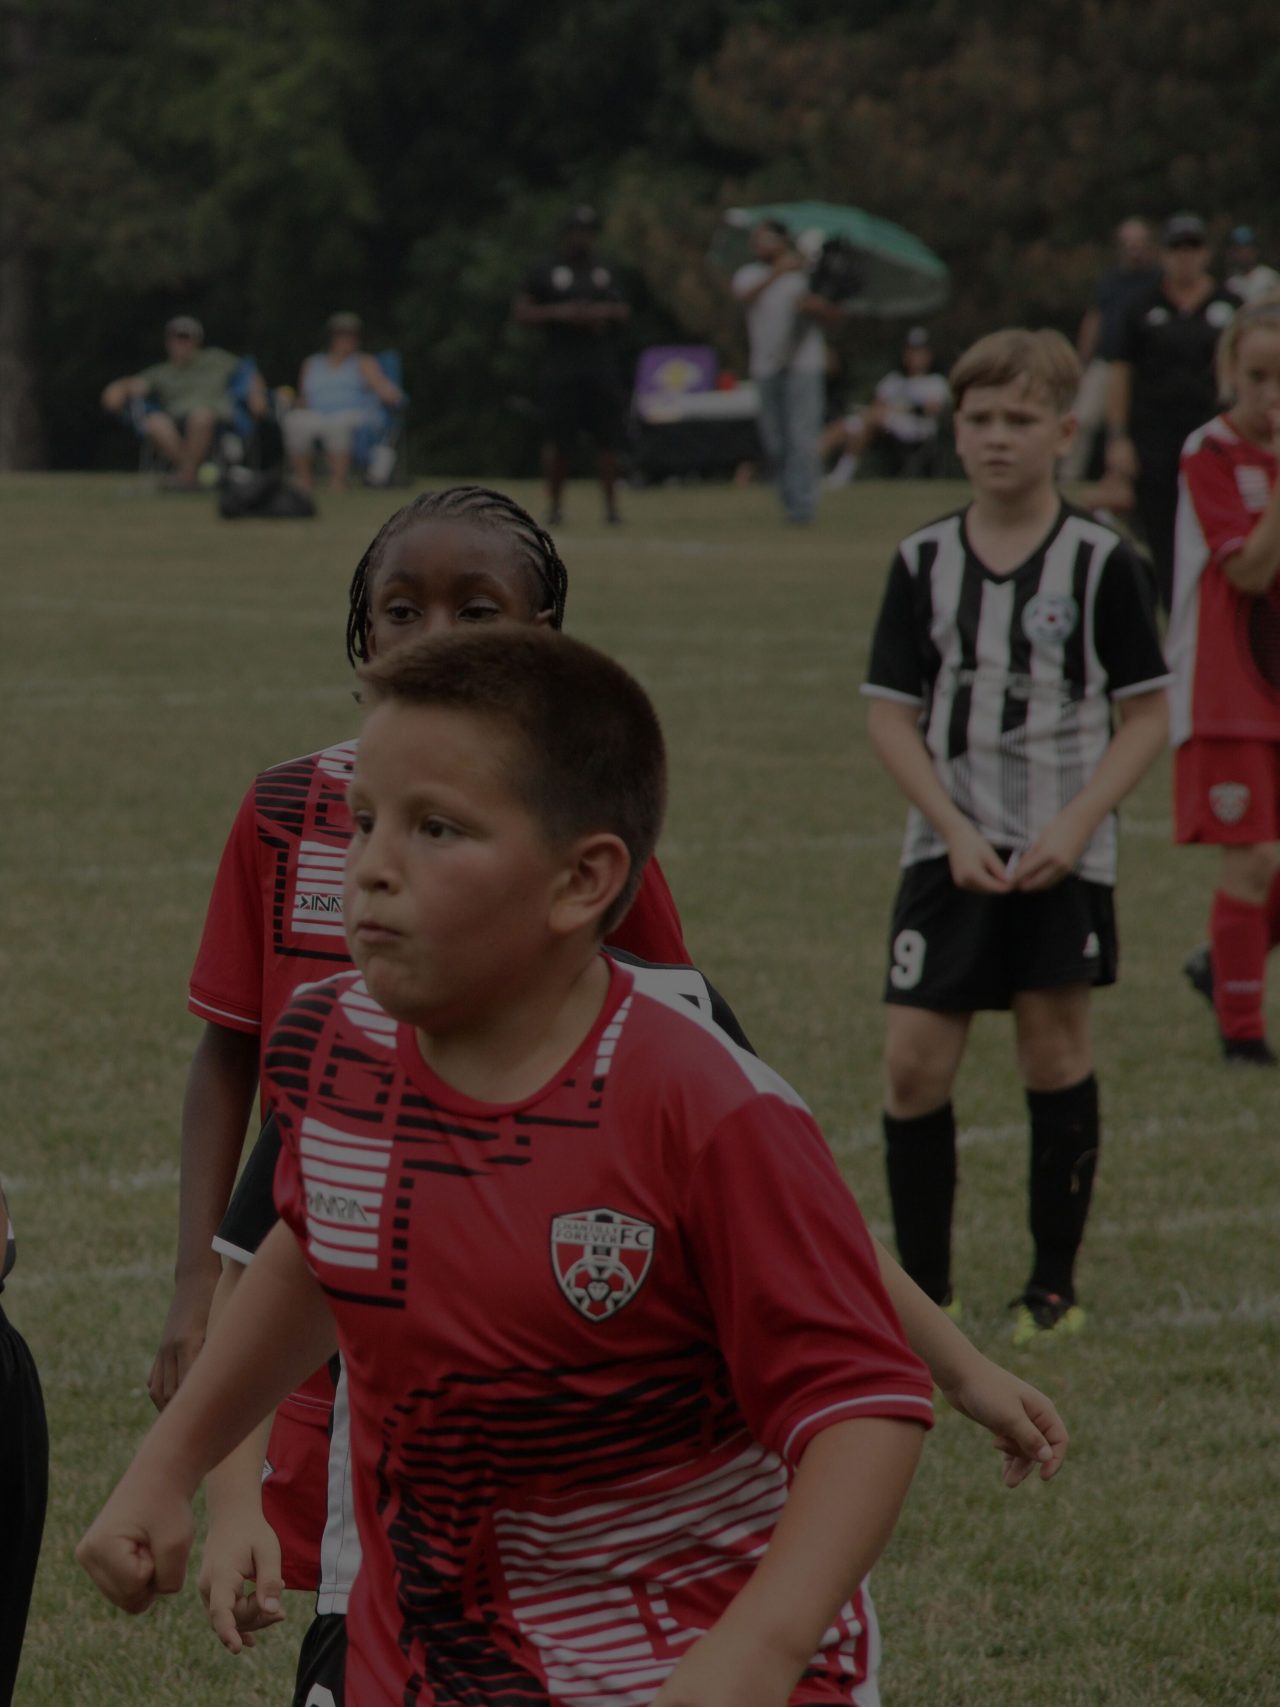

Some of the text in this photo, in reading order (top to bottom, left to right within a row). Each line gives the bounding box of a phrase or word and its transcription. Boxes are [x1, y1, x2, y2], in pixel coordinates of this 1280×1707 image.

[890, 928, 928, 991] 9
[556, 1230, 617, 1243] FOREVER
[621, 1227, 650, 1246] FC
